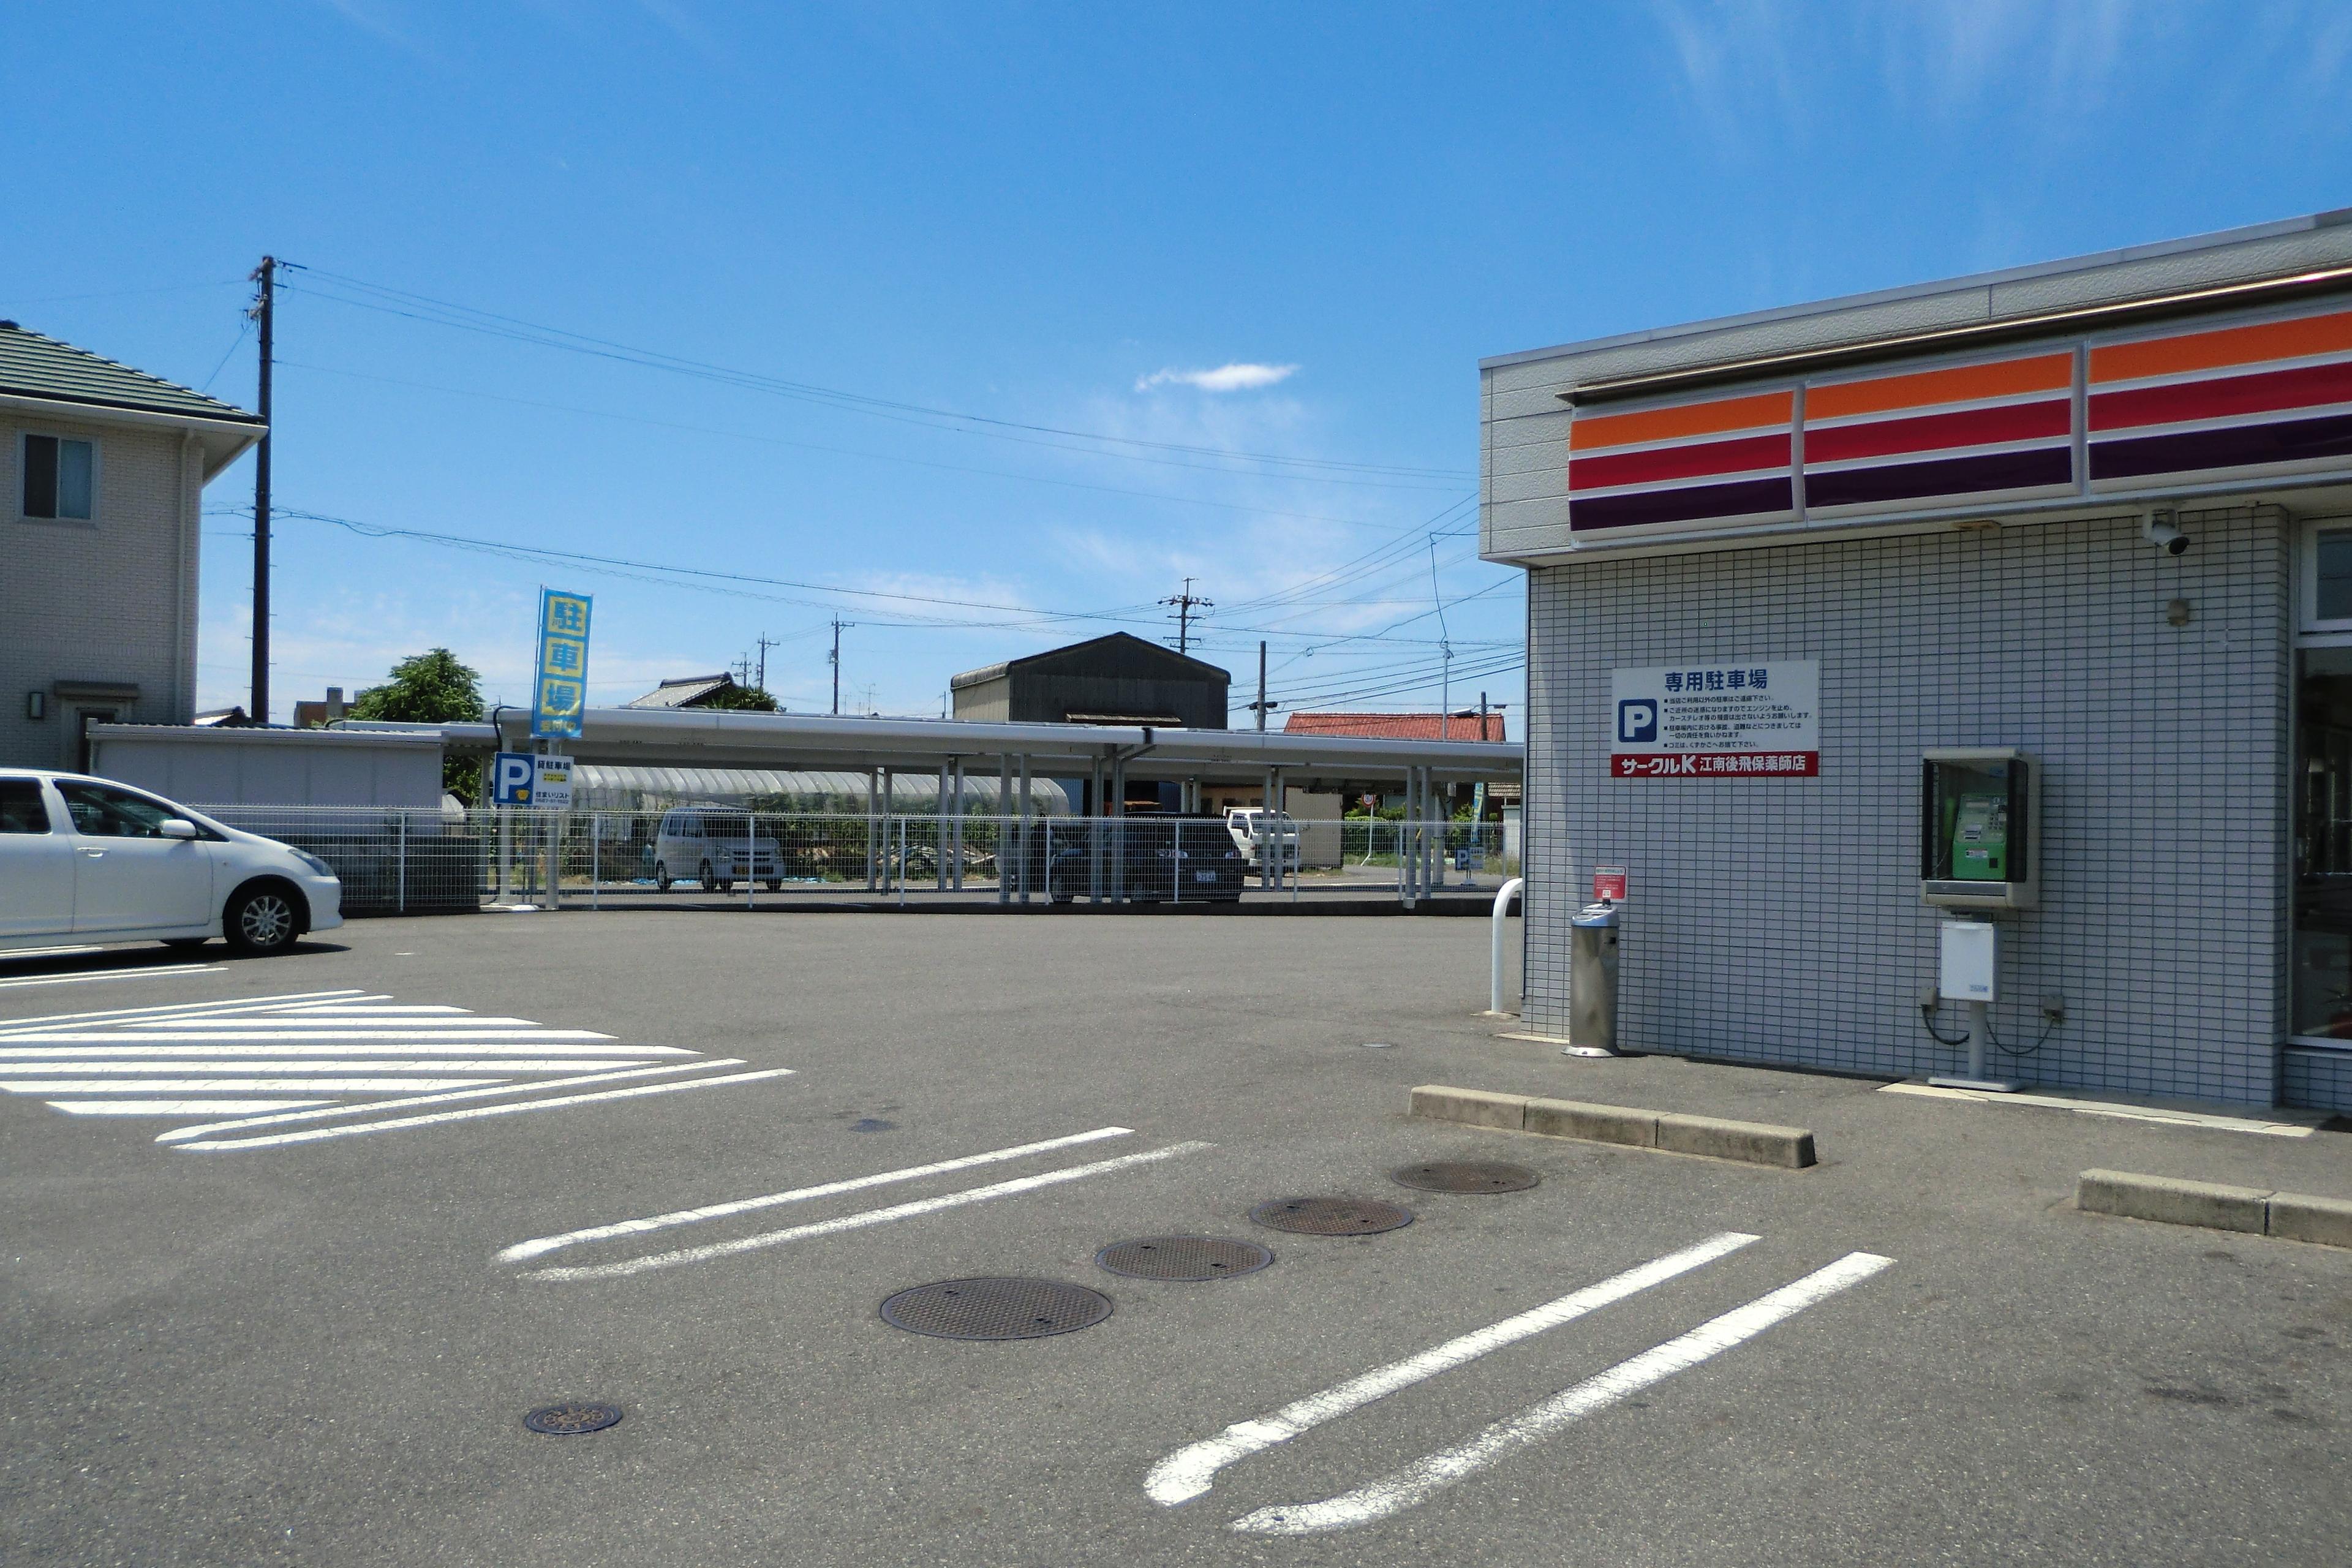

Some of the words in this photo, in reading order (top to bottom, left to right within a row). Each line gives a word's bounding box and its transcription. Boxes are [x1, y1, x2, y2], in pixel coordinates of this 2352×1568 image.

[545, 601, 582, 712] 駐車場
[1664, 669, 1768, 692] 専用駐車場
[1624, 705, 1653, 737] P
[538, 760, 571, 770] 貸駐車場
[1622, 755, 1696, 774] サークルK
[1700, 755, 1806, 772] 江南後飛保薬師店
[499, 758, 531, 799] P
